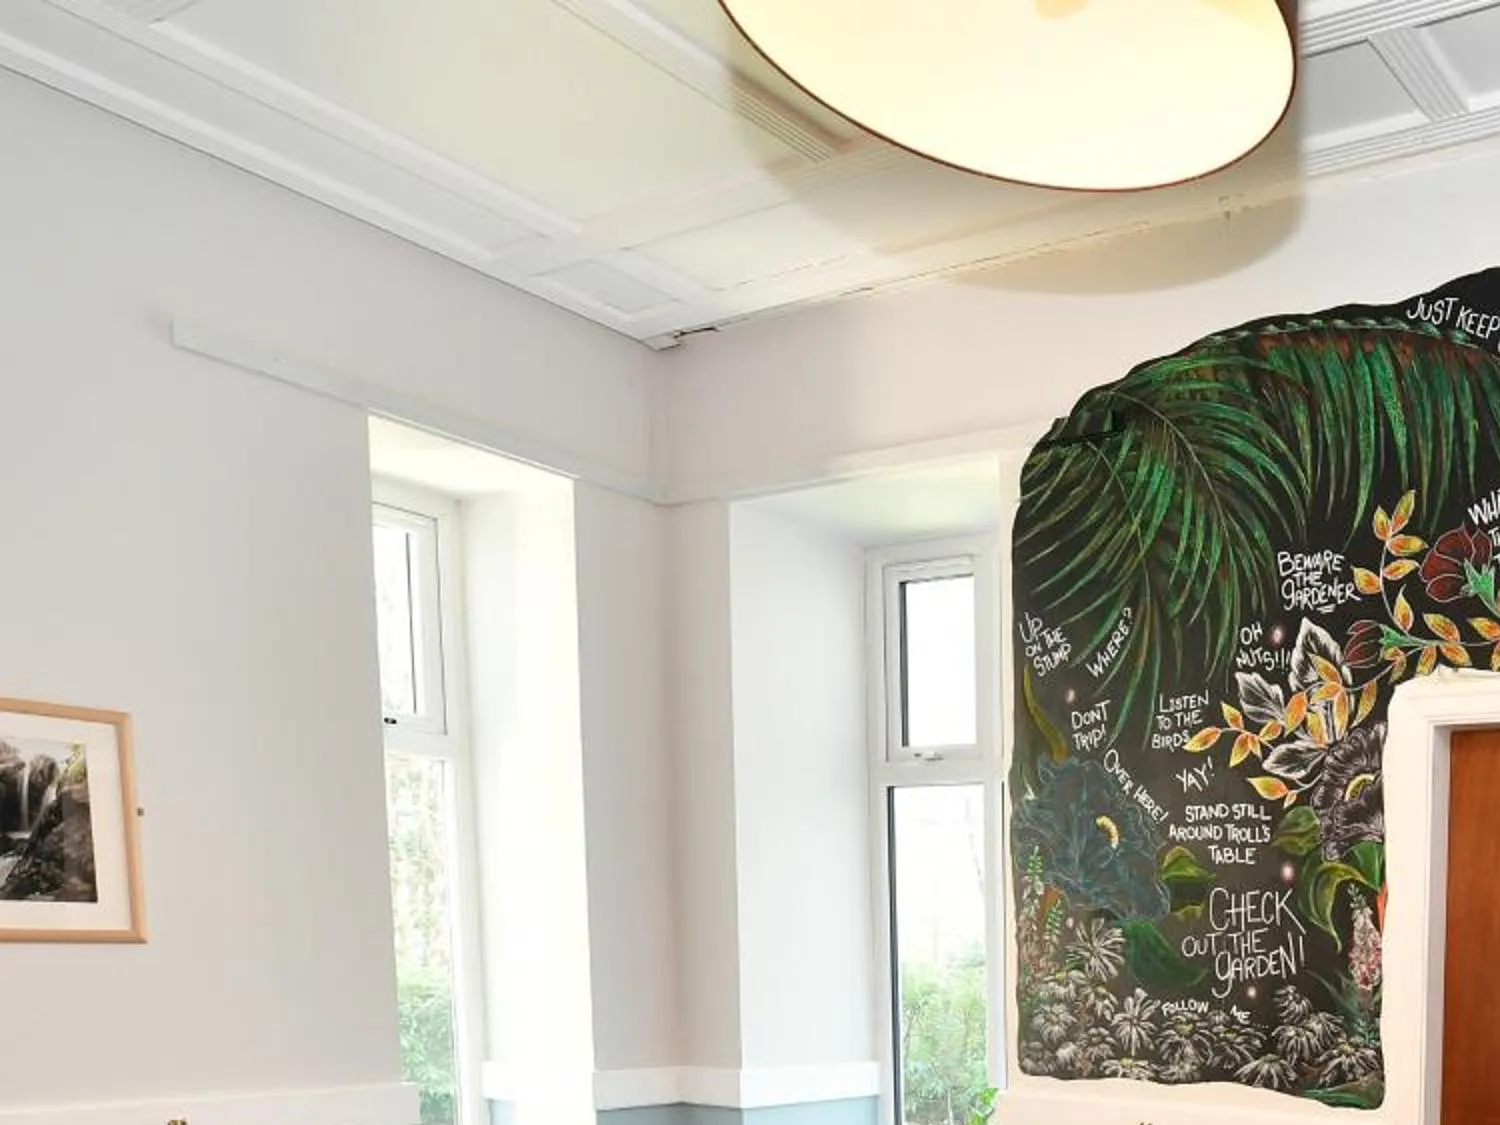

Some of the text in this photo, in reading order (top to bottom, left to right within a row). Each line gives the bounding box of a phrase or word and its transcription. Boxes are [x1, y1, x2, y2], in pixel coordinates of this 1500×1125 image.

[1406, 297, 1459, 325] JUST
[1456, 305, 1500, 340] KEEP
[1277, 550, 1345, 576] BEWARE
[1292, 571, 1323, 587] THE
[1019, 612, 1043, 642] UP
[1240, 621, 1263, 645] OH
[1085, 607, 1133, 678] WHERE?
[1033, 643, 1072, 677] STUMP
[1159, 689, 1209, 713] LISTEN
[1071, 700, 1111, 730] DONT
[1156, 709, 1204, 731] TO THE
[1072, 724, 1107, 751] TRIP!
[1151, 730, 1190, 752] BIRDS
[1103, 749, 1169, 824] OVER HERE!
[1175, 756, 1216, 793] YAY!
[1185, 803, 1272, 822] STAND STILL
[1168, 823, 1222, 842] AROUND
[1208, 845, 1257, 865] TABLE
[1209, 887, 1307, 935] CHECK
[1181, 927, 1270, 959] OUT THE
[1161, 998, 1209, 1017] FOLLOW
